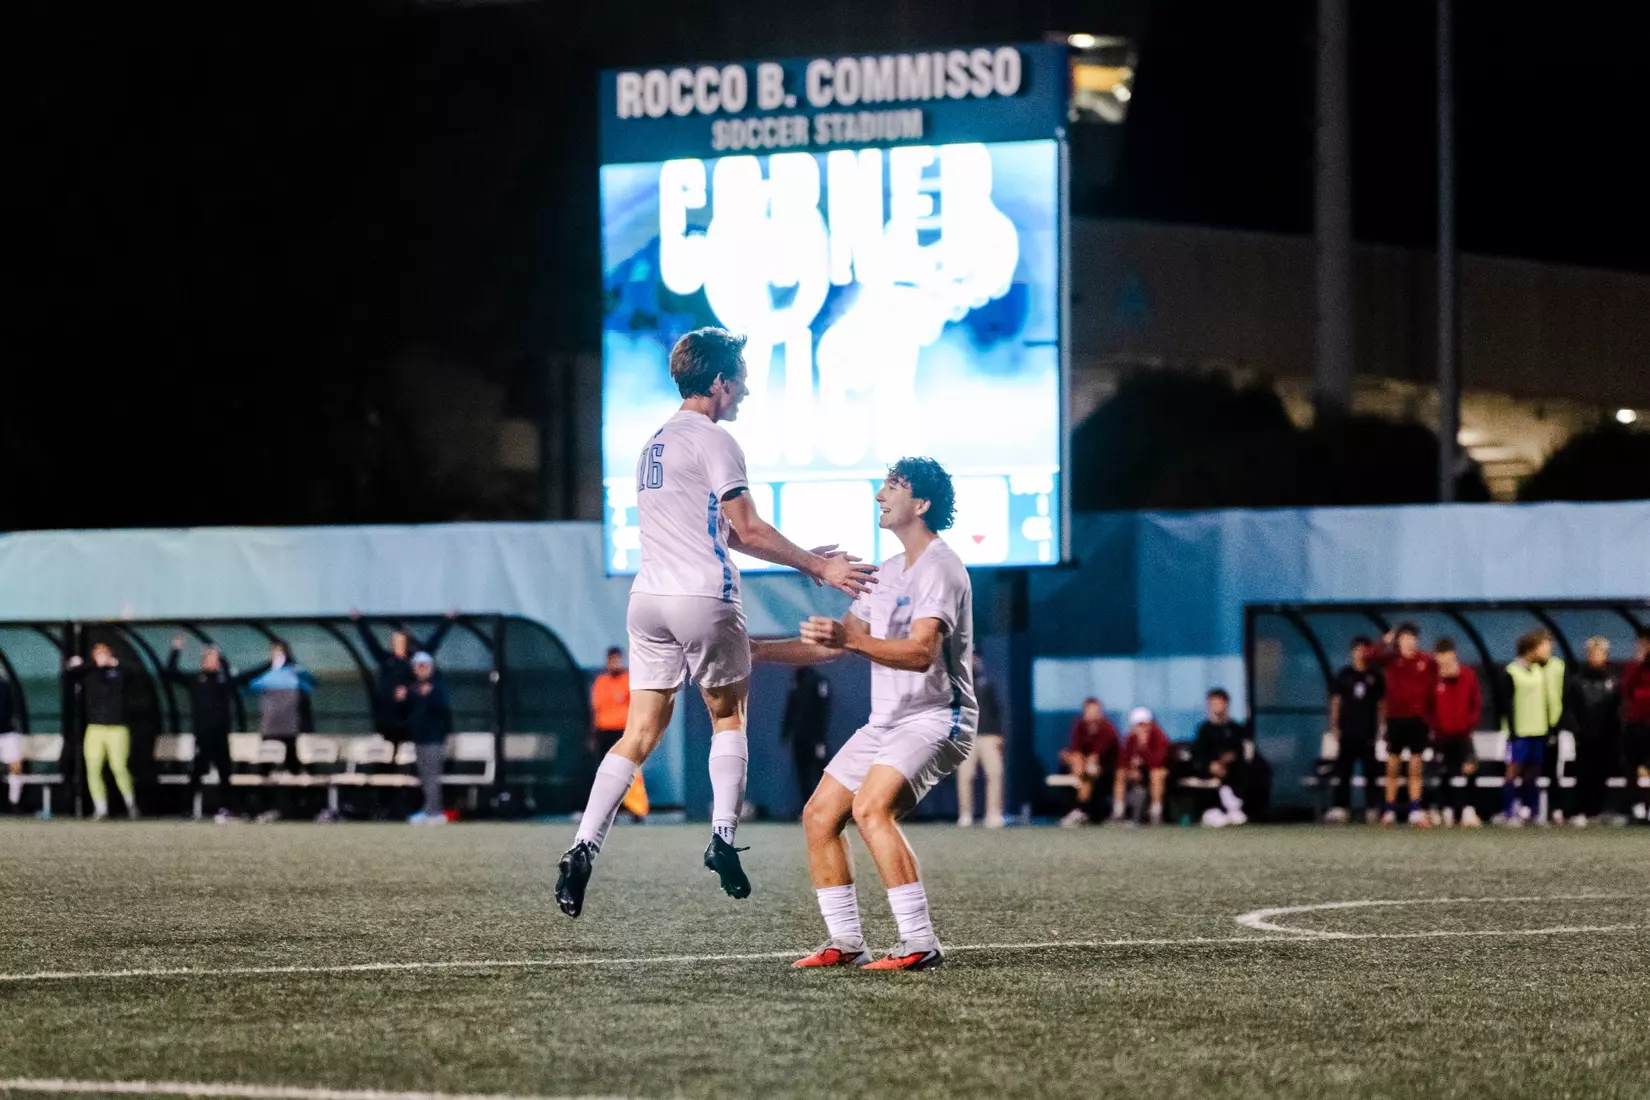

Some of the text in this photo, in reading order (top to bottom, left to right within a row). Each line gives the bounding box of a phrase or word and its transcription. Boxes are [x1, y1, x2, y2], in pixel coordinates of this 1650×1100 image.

[616, 46, 1022, 119] ROCCO B. COMMISSO
[711, 108, 923, 150] SOCCER STADIUM
[638, 443, 665, 492] 16
